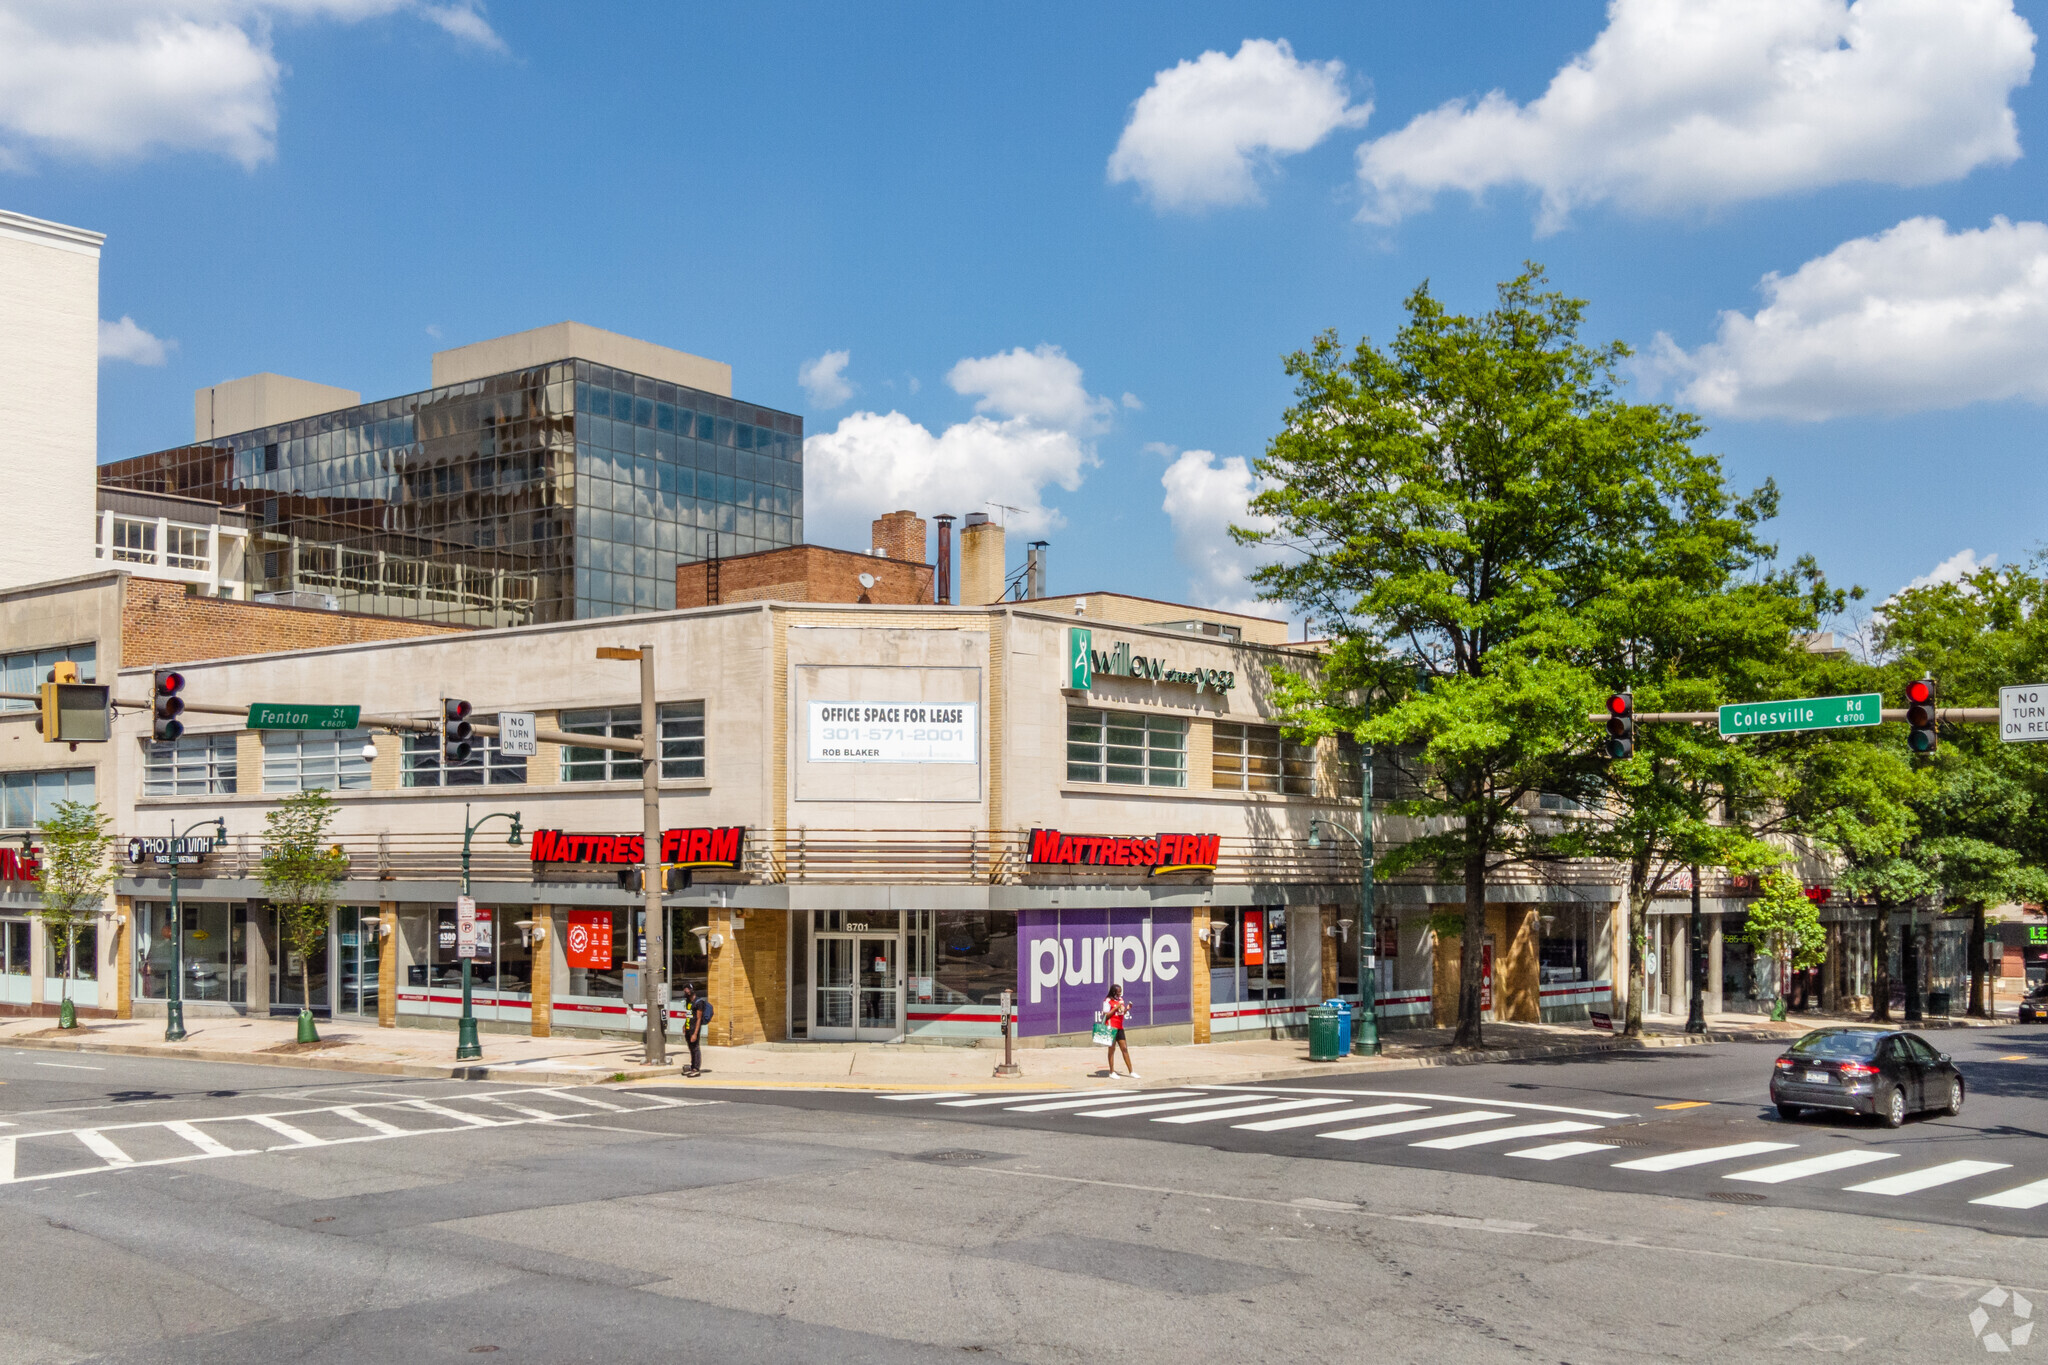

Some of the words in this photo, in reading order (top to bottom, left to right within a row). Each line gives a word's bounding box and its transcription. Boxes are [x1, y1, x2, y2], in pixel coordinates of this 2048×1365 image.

[1091, 642, 1165, 681] willow
[1196, 667, 1236, 695] yoga
[2018, 693, 2038, 703] NO
[261, 710, 309, 724] Fenton
[333, 708, 345, 719] St
[822, 708, 860, 722] OFFICE
[864, 708, 900, 723] SPACE
[904, 709, 926, 723] FOR
[930, 709, 963, 723] LEASE
[1734, 708, 1814, 726] Colesville
[1847, 700, 1862, 712] Rd
[1843, 713, 1865, 722] 8700
[2012, 707, 2045, 718] TURN
[511, 718, 524, 727] NO
[2006, 723, 2022, 733] ON
[508, 729, 529, 738] TURN
[823, 728, 963, 741] 301-571-2001
[504, 741, 514, 750] ON
[518, 742, 533, 751] RED
[844, 749, 880, 757] BLAKER
[144, 839, 164, 853] PHO
[530, 830, 645, 863] MATTRES
[846, 923, 869, 931] 8701
[1030, 918, 1180, 1003] purple
